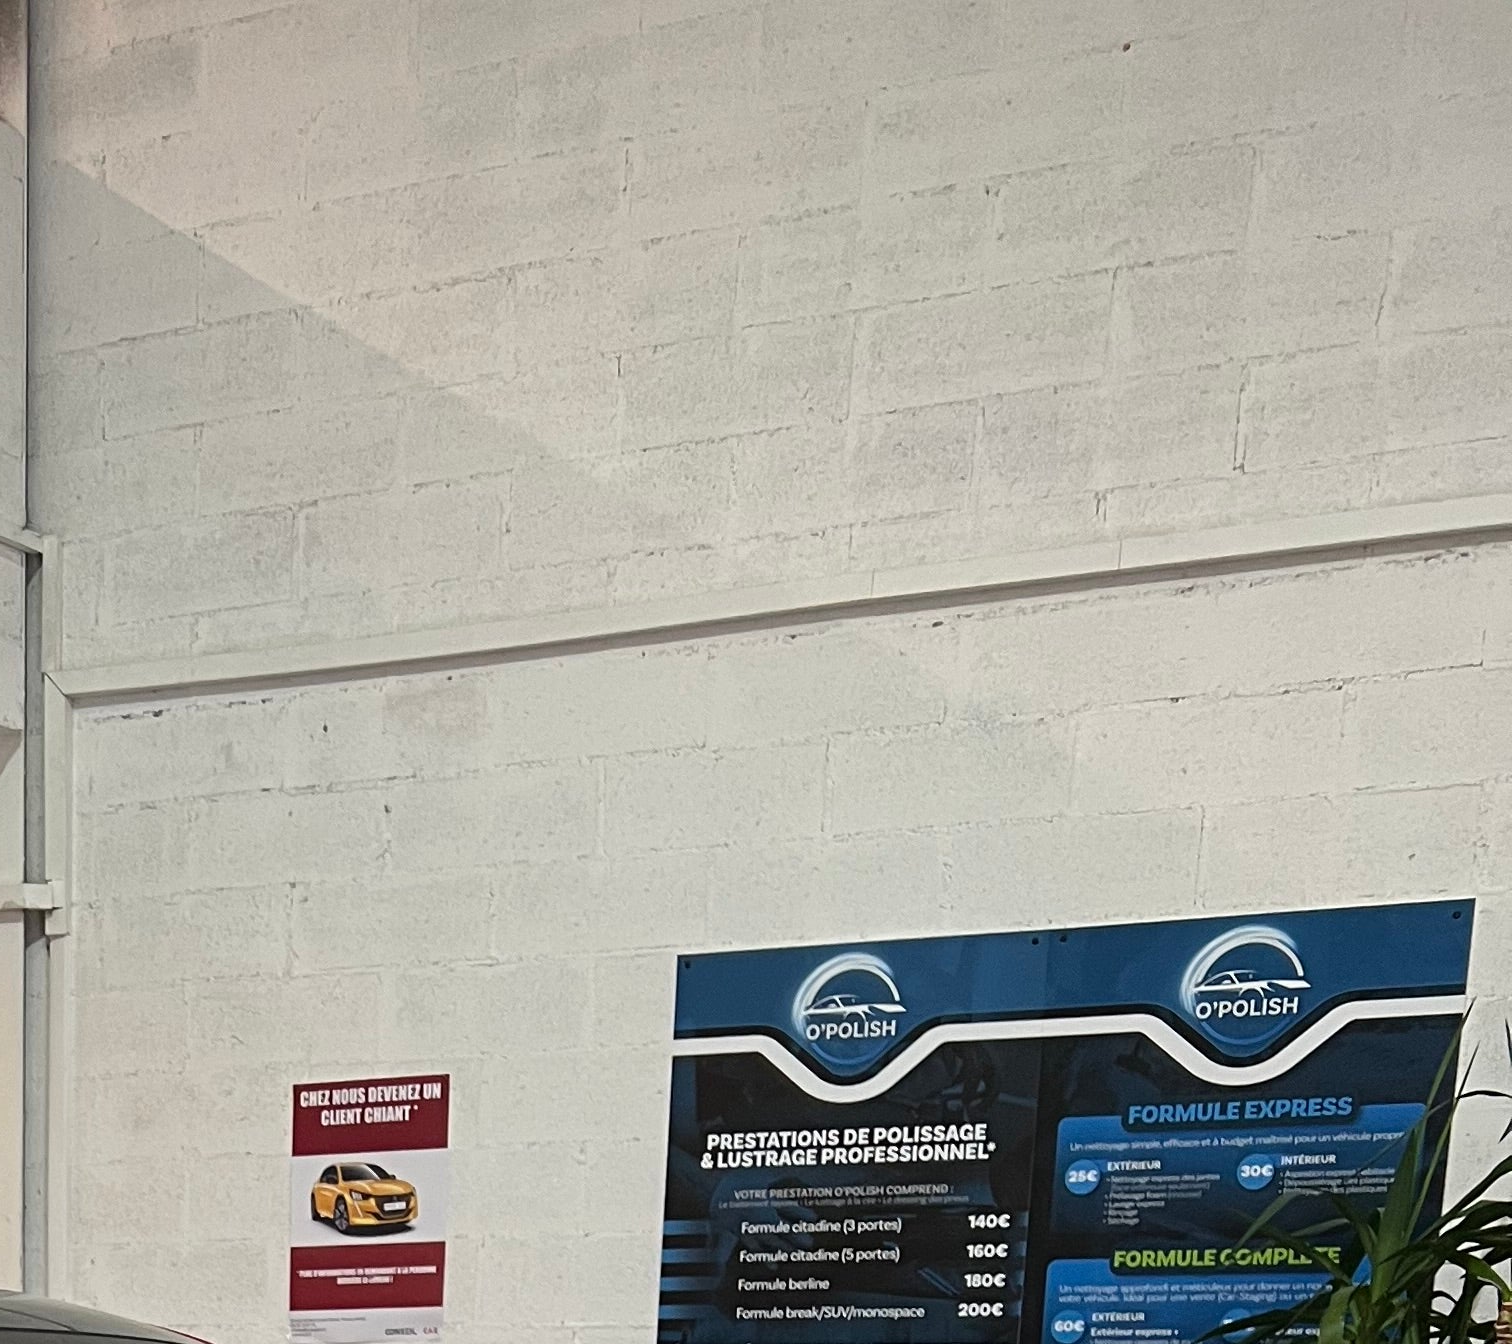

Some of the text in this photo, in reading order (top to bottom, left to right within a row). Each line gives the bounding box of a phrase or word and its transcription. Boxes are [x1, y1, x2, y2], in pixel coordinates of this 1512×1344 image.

[1195, 996, 1299, 1019] O'POLISH
[806, 1020, 896, 1040] O'POLISH
[300, 1082, 442, 1108] CHEZ NOUS DEVENEZ UN
[321, 1105, 411, 1126] CLIENT CHIANT
[1128, 1096, 1353, 1124] FORMULE EXPRESS
[707, 1123, 987, 1150] PRESTATIONS DE POLISSAGE
[1294, 1134, 1316, 1145] pour
[1318, 1134, 1331, 1142] un
[1332, 1131, 1371, 1142] véhicule
[700, 1153, 714, 1169] &
[717, 1148, 817, 1168] LUSTRAGE
[1241, 1153, 1336, 1177] 30€ INTÉRIEUR
[1069, 1170, 1097, 1183] 25€
[734, 1188, 767, 1200] VOTRE
[769, 1186, 833, 1198] PRESTATION
[834, 1185, 884, 1197] O'POLISH
[886, 1184, 948, 1196] COMPREND
[741, 1218, 902, 1235] Formule citadine (3 portes)
[968, 1213, 1010, 1229] 140€
[739, 1247, 900, 1264] Formule citadine (5 portes)
[967, 1244, 1009, 1259] 160€
[1113, 1249, 1216, 1269] FORMULE
[738, 1277, 829, 1292] Formule berline
[964, 1273, 1006, 1288] 180€
[736, 1304, 925, 1320] Formule break/SUV/monospace
[958, 1302, 1003, 1318] 200€
